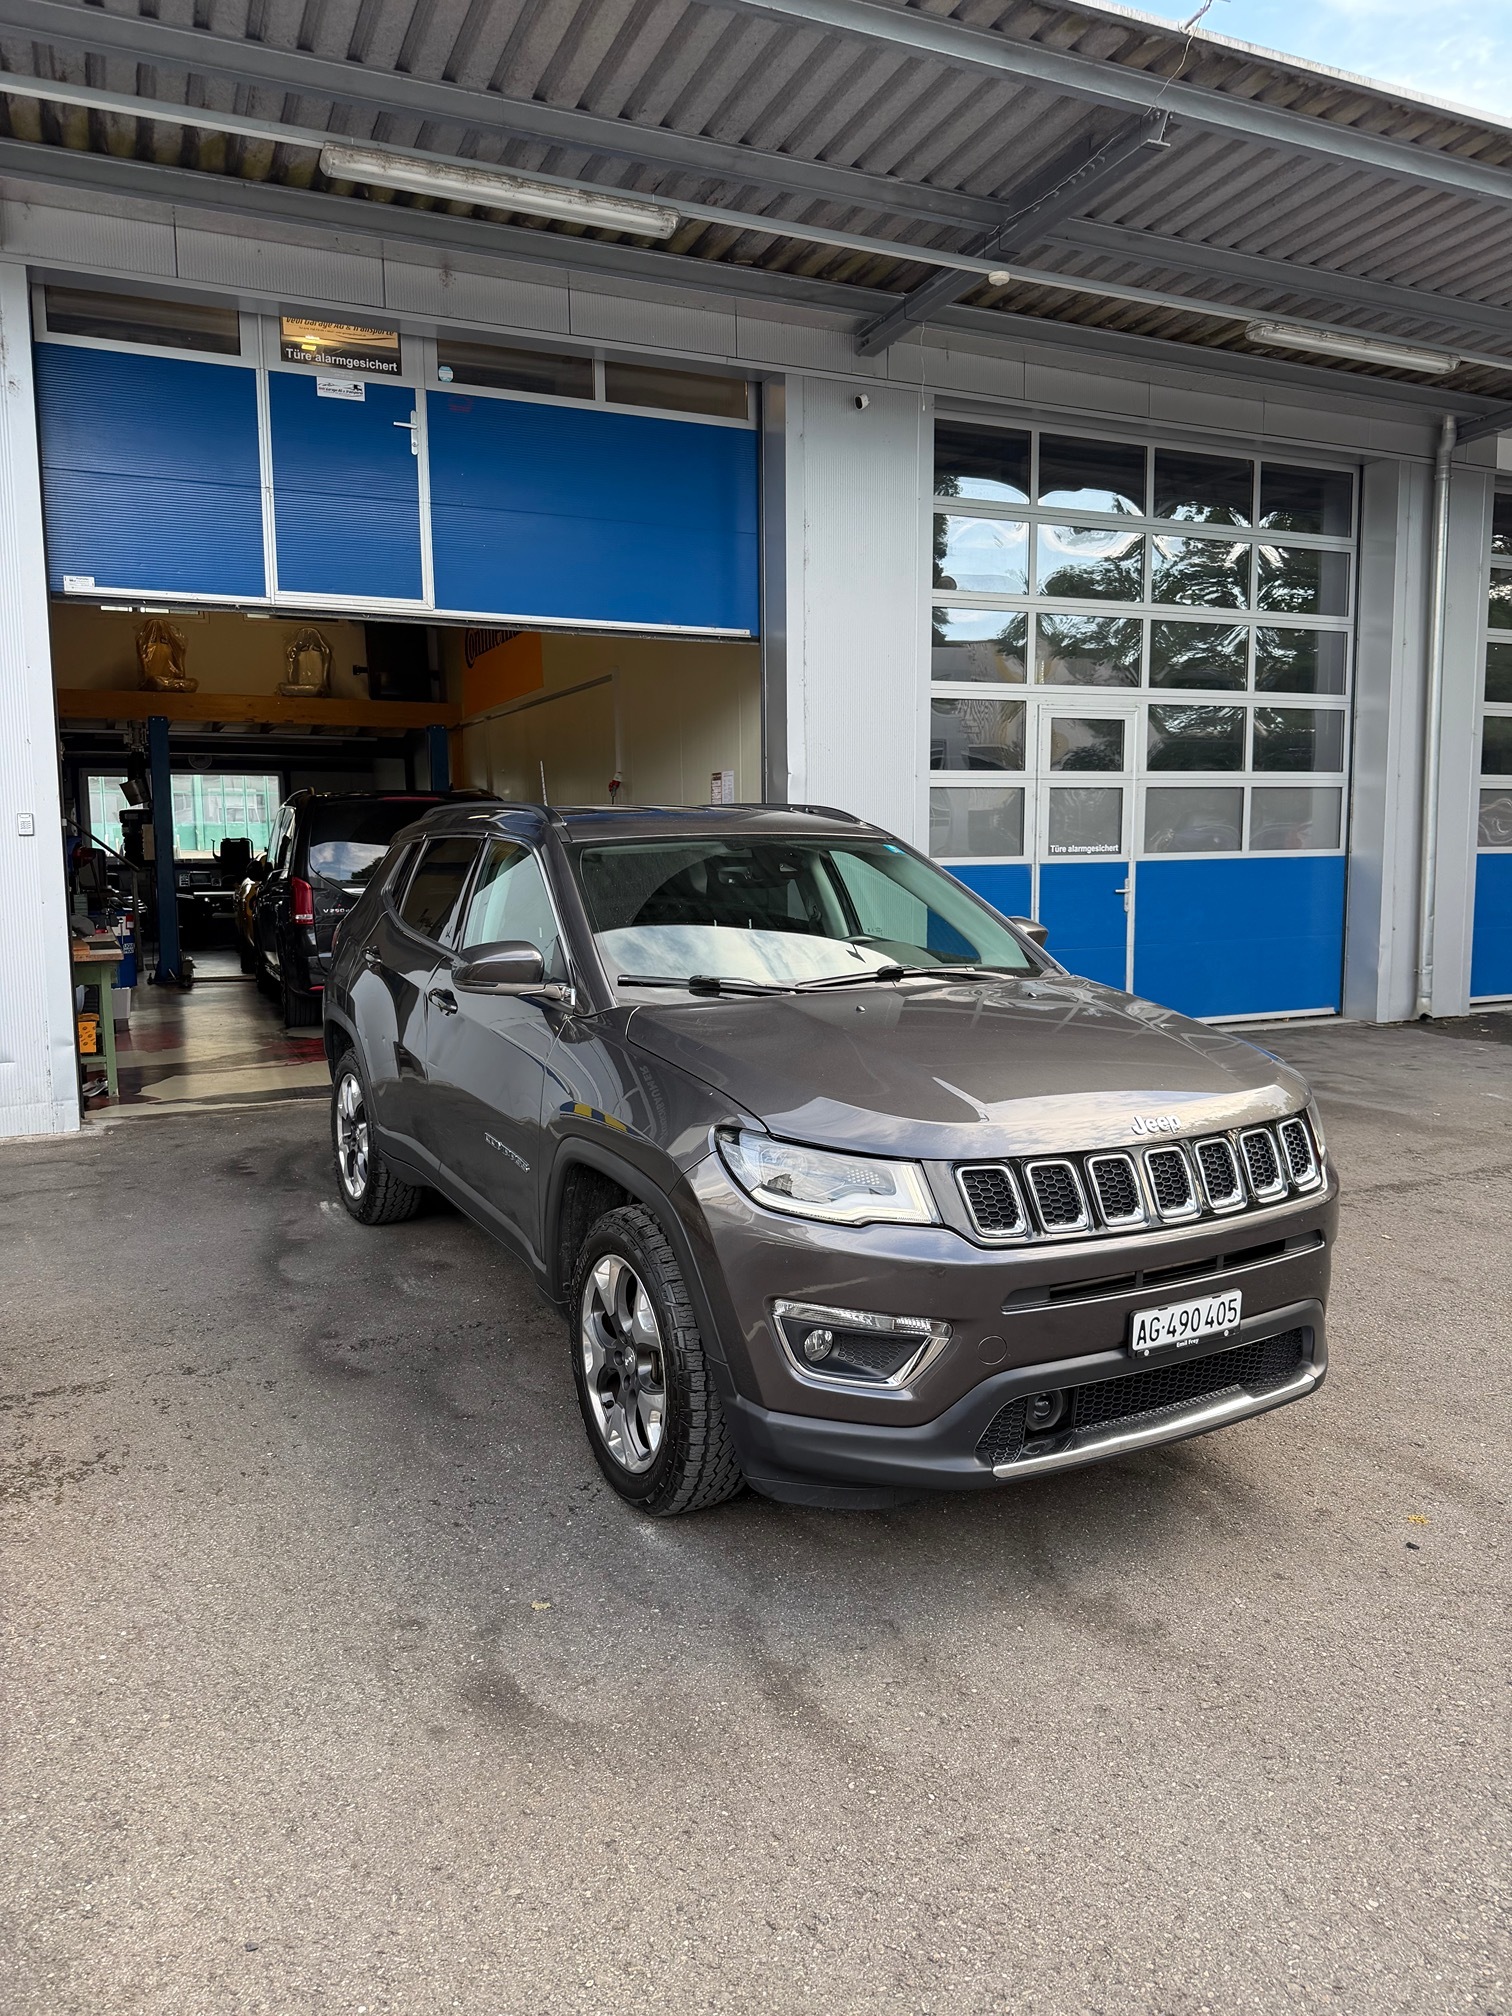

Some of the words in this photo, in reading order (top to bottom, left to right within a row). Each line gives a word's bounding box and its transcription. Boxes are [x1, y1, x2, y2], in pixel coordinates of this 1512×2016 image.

[286, 348, 312, 360] Türe
[315, 353, 398, 371] alarmgesichert
[1067, 844, 1119, 853] alarmgesichert
[1131, 1115, 1181, 1135] Jeep
[1176, 1340, 1188, 1348] Emil
